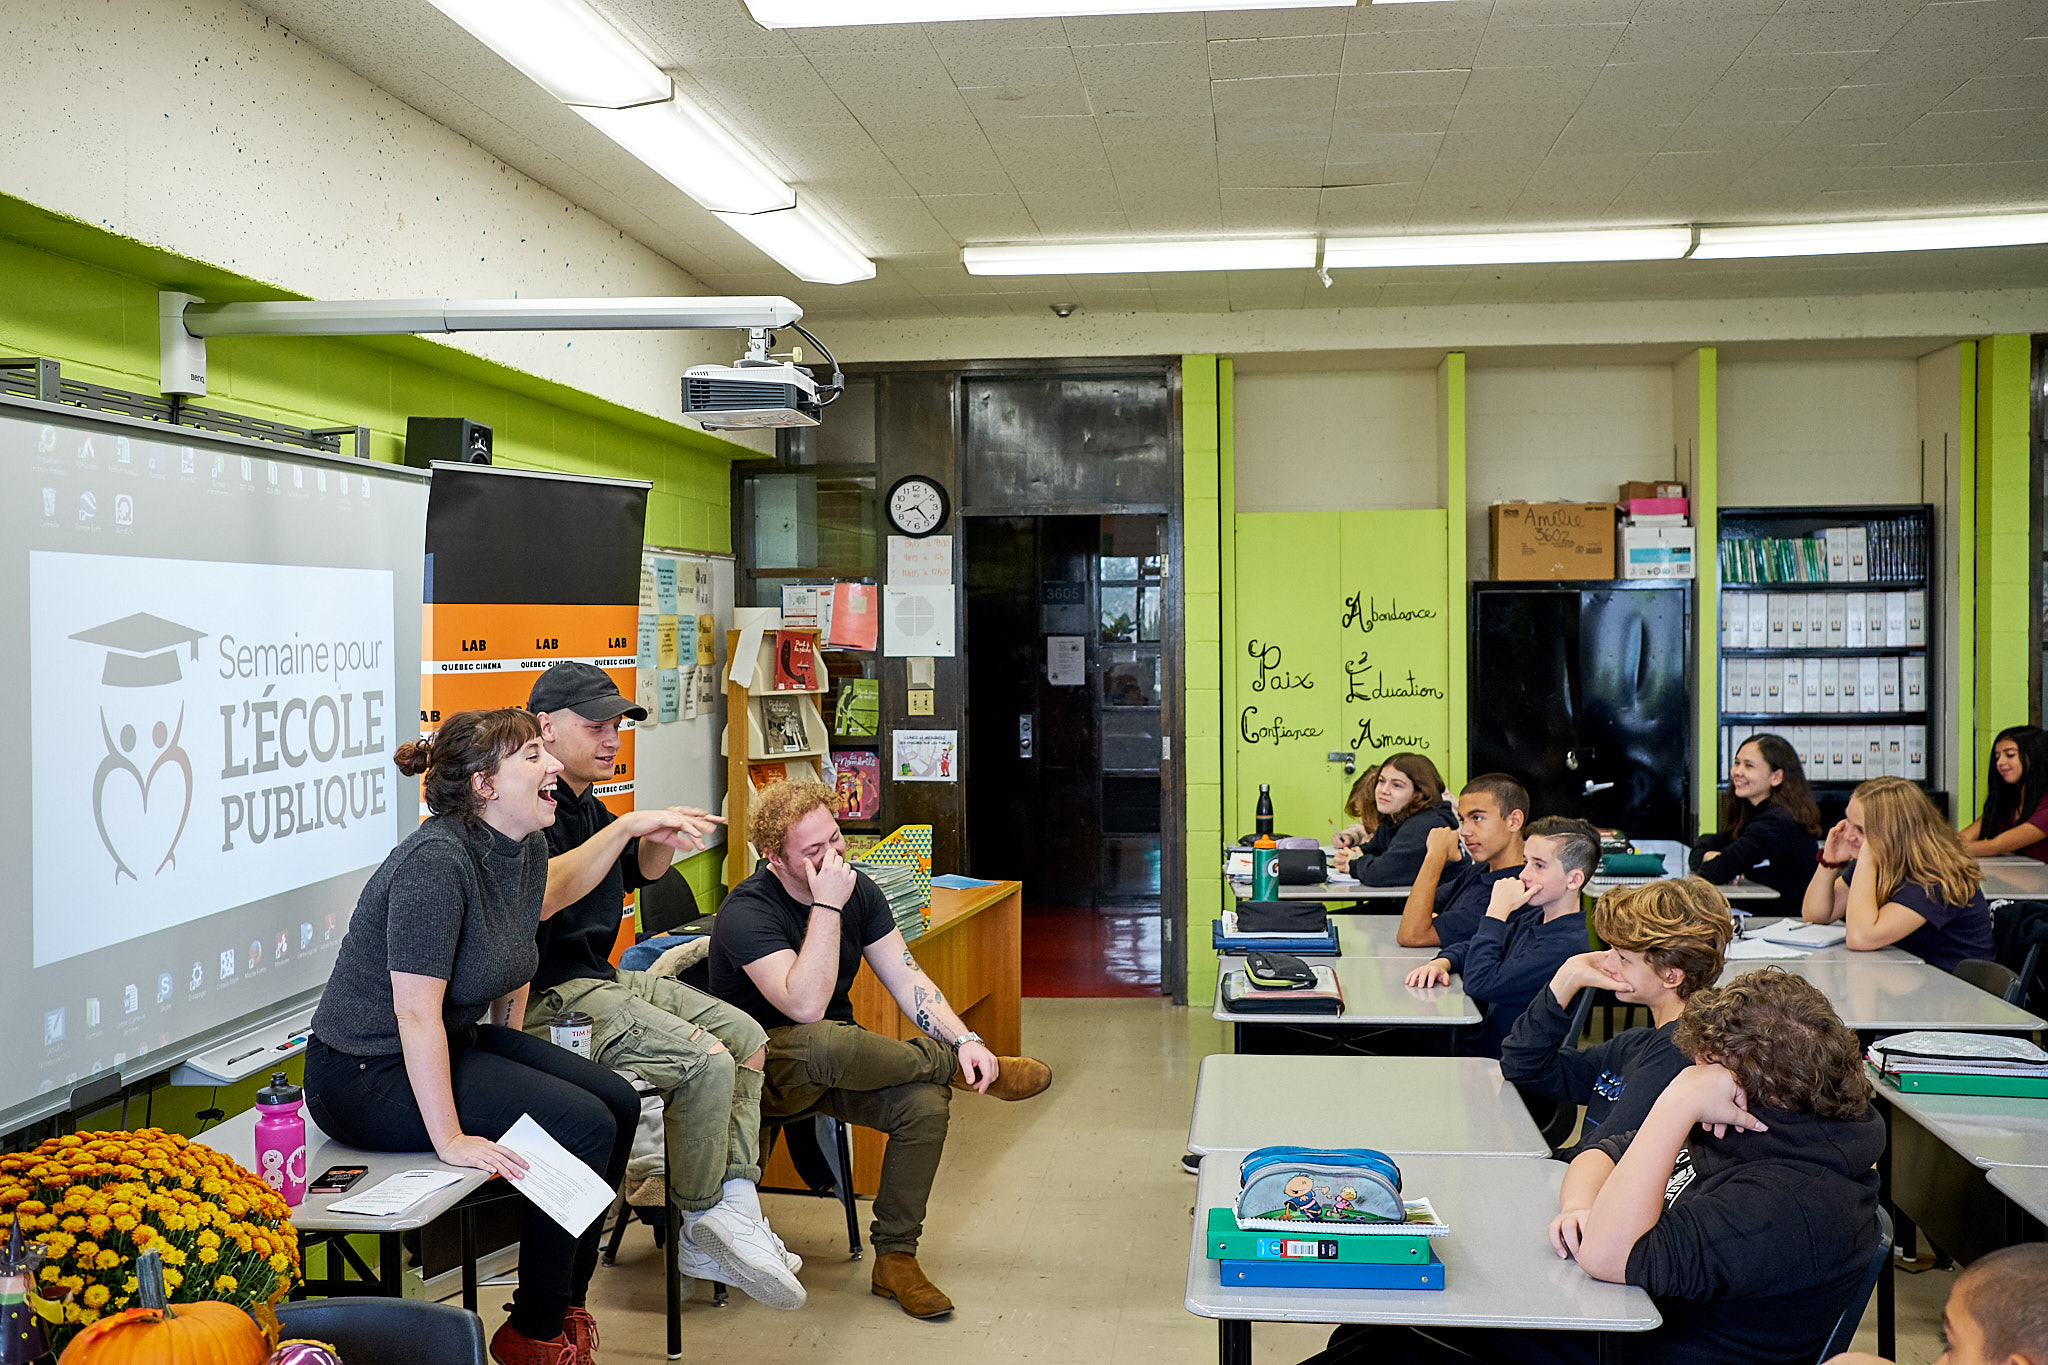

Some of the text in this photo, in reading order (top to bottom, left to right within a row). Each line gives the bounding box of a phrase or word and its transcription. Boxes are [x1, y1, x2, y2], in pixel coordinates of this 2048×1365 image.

[924, 487, 928, 495] 1
[1046, 588, 1079, 600] 3605
[1342, 591, 1437, 633] Abondance
[462, 639, 487, 652] LAB
[536, 638, 559, 650] LAB
[608, 637, 627, 649] LAB
[219, 631, 383, 682] Semaine pour
[594, 658, 618, 666] QUÉBEC
[441, 662, 502, 671] QUÉBEC CINÉMA
[520, 661, 547, 669] QUÉBEC
[1248, 639, 1314, 692] Paix
[1345, 652, 1444, 703] Éducation
[219, 683, 385, 780] L'ÉCOLE
[1241, 706, 1324, 745] Confiance
[1350, 719, 1429, 749] Amour
[840, 756, 876, 767] Nombrils
[613, 764, 627, 776] AB
[593, 785, 617, 795] QUÉBEC
[221, 767, 386, 853] PUBLIQUE
